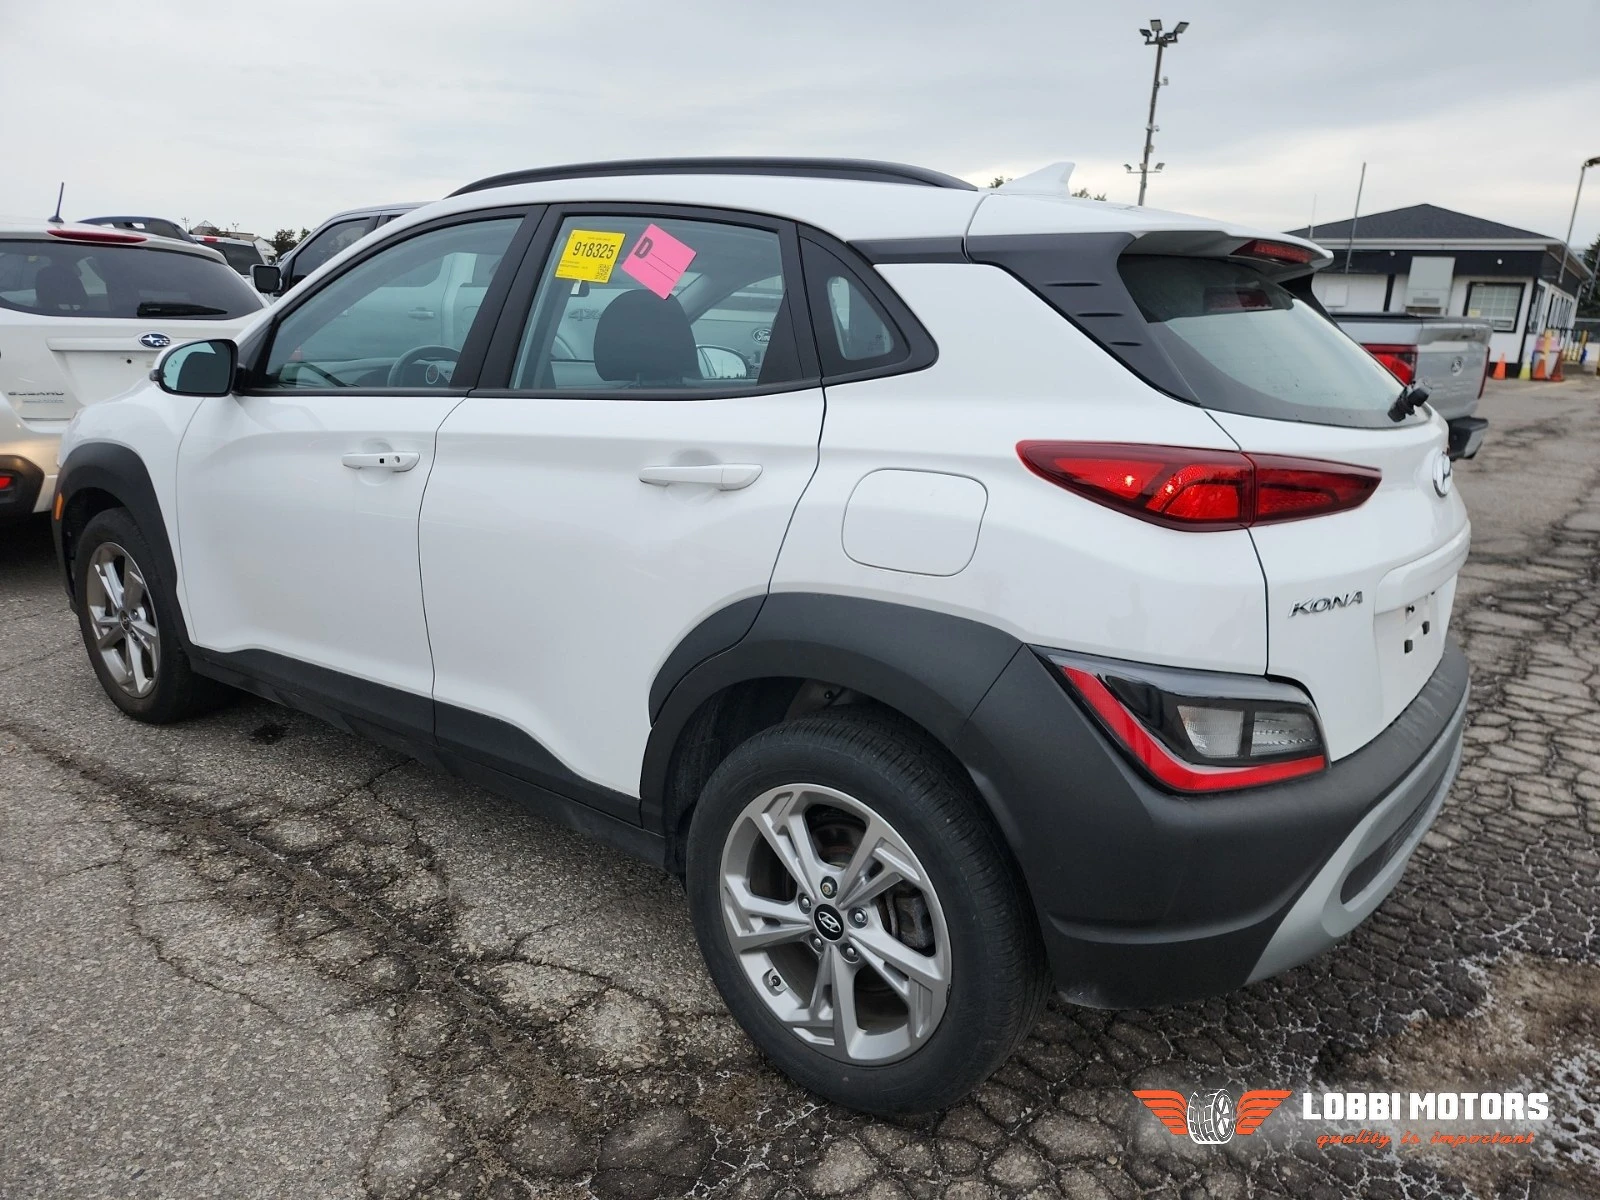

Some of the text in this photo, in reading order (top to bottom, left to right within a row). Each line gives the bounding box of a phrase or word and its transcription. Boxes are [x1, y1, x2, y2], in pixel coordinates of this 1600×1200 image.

[572, 241, 616, 259] 918325
[634, 237, 653, 259] D
[1288, 590, 1363, 619] KONA
